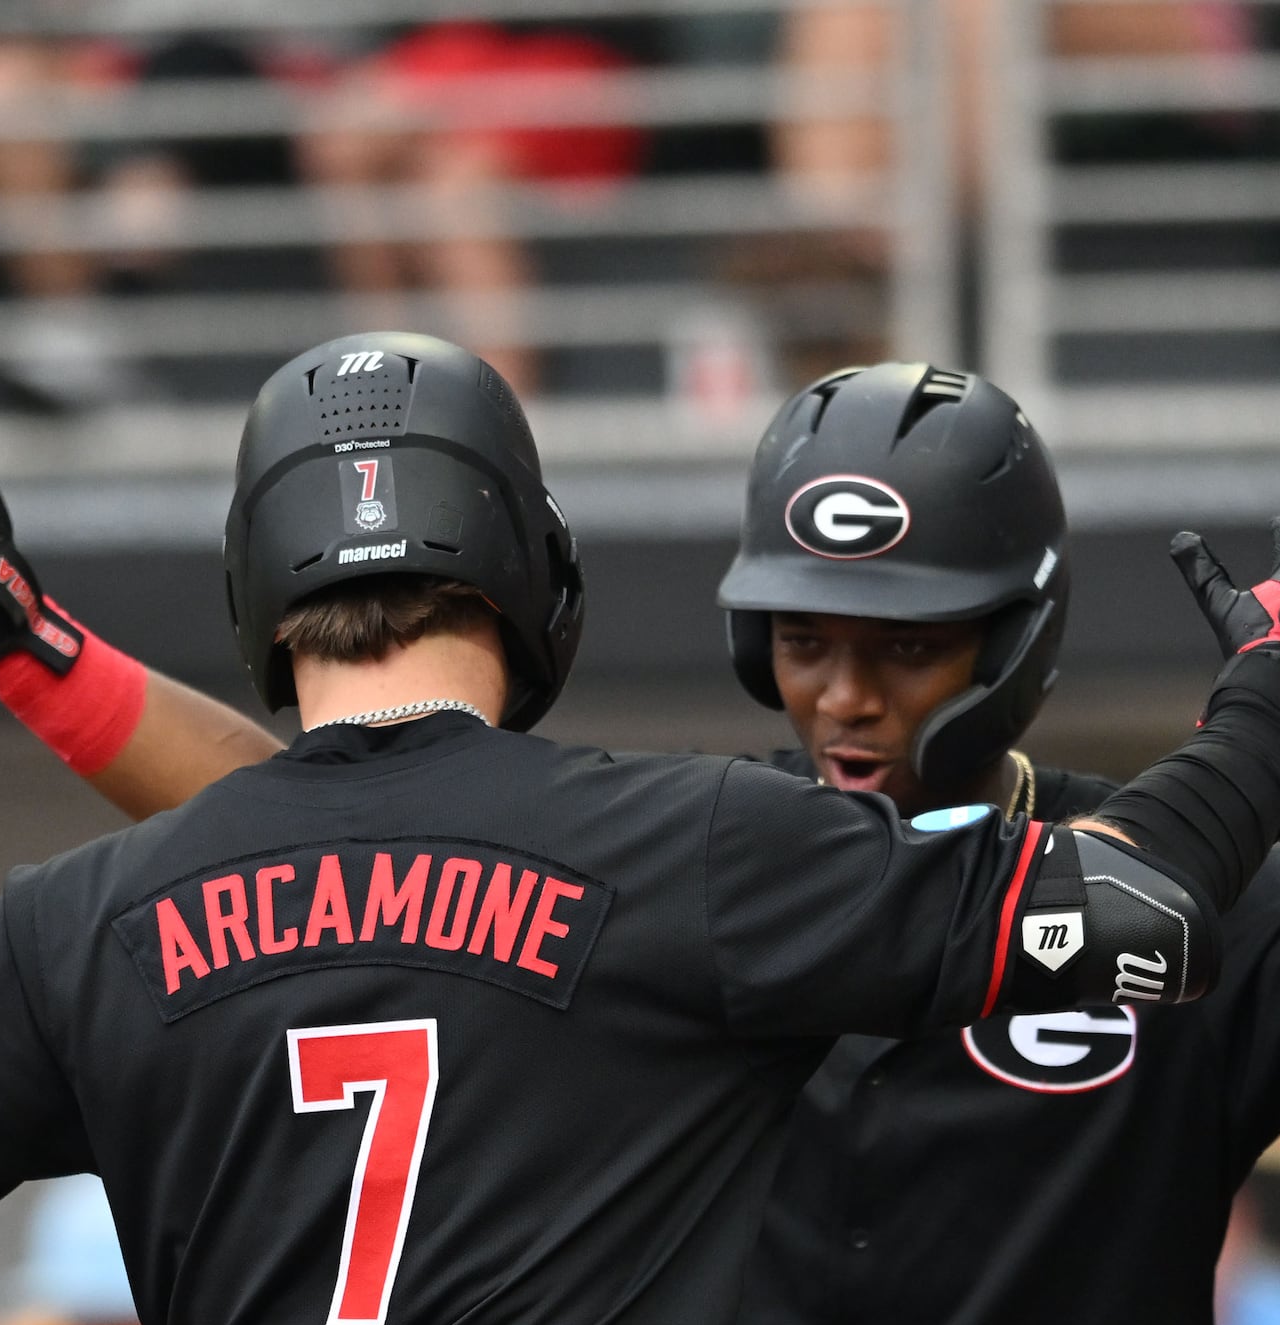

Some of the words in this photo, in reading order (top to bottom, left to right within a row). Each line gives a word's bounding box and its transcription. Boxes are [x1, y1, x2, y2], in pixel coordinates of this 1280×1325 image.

[355, 439, 390, 449] Protected
[354, 460, 378, 501] 7
[338, 540, 407, 564] marucci
[155, 852, 584, 995] ARCAMONE
[1038, 924, 1070, 950] m
